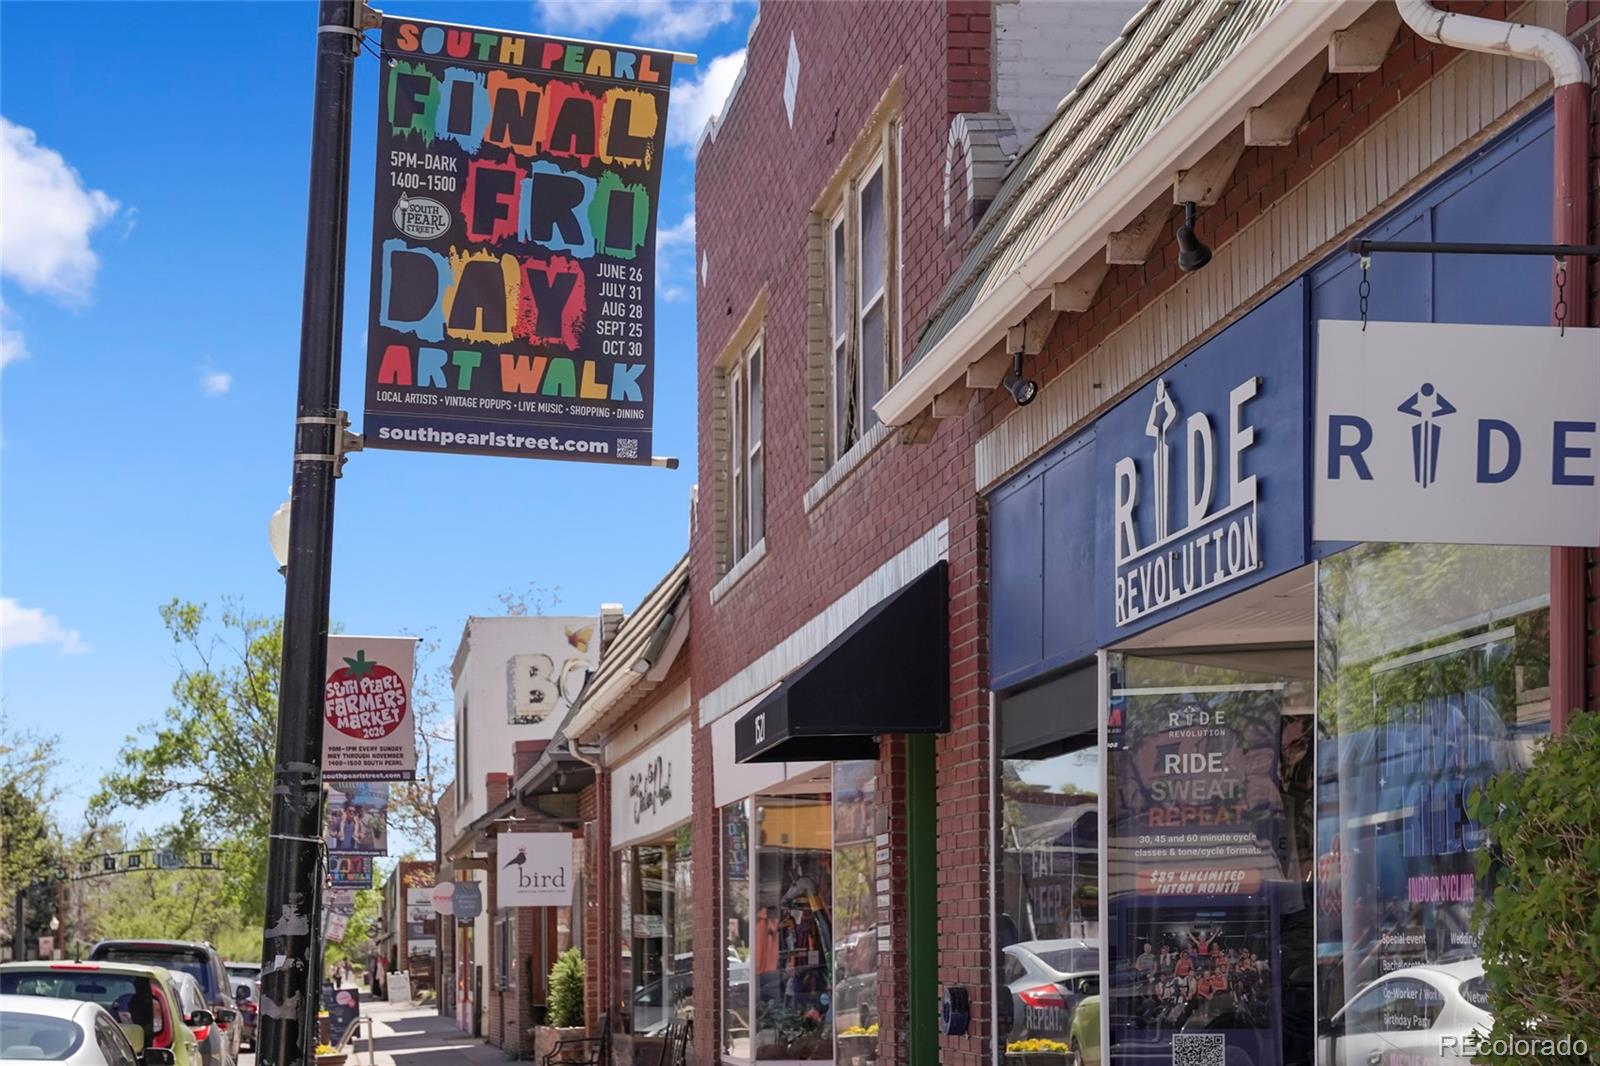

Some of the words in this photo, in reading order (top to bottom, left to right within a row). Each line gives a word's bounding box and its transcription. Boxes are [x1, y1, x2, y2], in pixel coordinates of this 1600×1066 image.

[397, 24, 525, 66] SOUTH
[541, 43, 659, 83] PEARL
[391, 68, 653, 160] FINAL
[390, 151, 457, 173] 5PM-DARK
[390, 173, 456, 192] 1400-1500
[409, 204, 440, 215] SOUTH
[468, 160, 642, 254] FRI
[407, 213, 446, 230] PEARL
[407, 225, 436, 234] STREET
[596, 263, 626, 280] JUNE
[629, 267, 643, 282] 26
[384, 244, 582, 344] DAY
[598, 282, 626, 300] JULY
[629, 286, 642, 301] 31
[602, 303, 626, 318] AUG
[629, 305, 643, 319] 28
[596, 320, 626, 337] SEPT
[629, 323, 643, 338] 25
[602, 340, 625, 356] OCT
[628, 341, 642, 357] 30
[377, 345, 482, 391] ART
[500, 354, 647, 402] WALK
[376, 390, 403, 404] LOCAL
[404, 392, 438, 406] ARTISTS
[445, 395, 478, 409] VINTAGE
[479, 396, 512, 411] POPUPS
[518, 399, 536, 413] LIVE
[537, 401, 564, 415] MUSIC
[570, 404, 610, 418] SHOPPING
[616, 408, 645, 420] DINING
[379, 424, 609, 454] southpearlstreet.com
[1115, 512, 1258, 625] REVOLUTION
[326, 679, 359, 699] SOUTH
[360, 675, 402, 694] PEARL
[325, 689, 405, 718] FARMERS
[337, 708, 400, 730] MARKET
[1168, 729, 1226, 738] REVOLUTION
[1164, 752, 1230, 775] RIDE.
[1151, 778, 1243, 801] SWEAT.
[1139, 835, 1153, 845] 30,
[1154, 835, 1166, 844] 45
[1168, 835, 1185, 843] and
[1186, 834, 1198, 842] 60
[1200, 833, 1231, 843] minute
[1233, 832, 1257, 844] cycle
[1134, 849, 1167, 857] classes
[1178, 847, 1225, 857] tone/cycle
[1226, 846, 1262, 855] formats
[517, 866, 566, 888] bird
[1179, 870, 1246, 882] UNLIMITED
[1156, 883, 1194, 895] INTRO
[1197, 882, 1240, 894] MONTH
[1408, 876, 1440, 902] INDOOR
[1440, 873, 1475, 902] CYCLING
